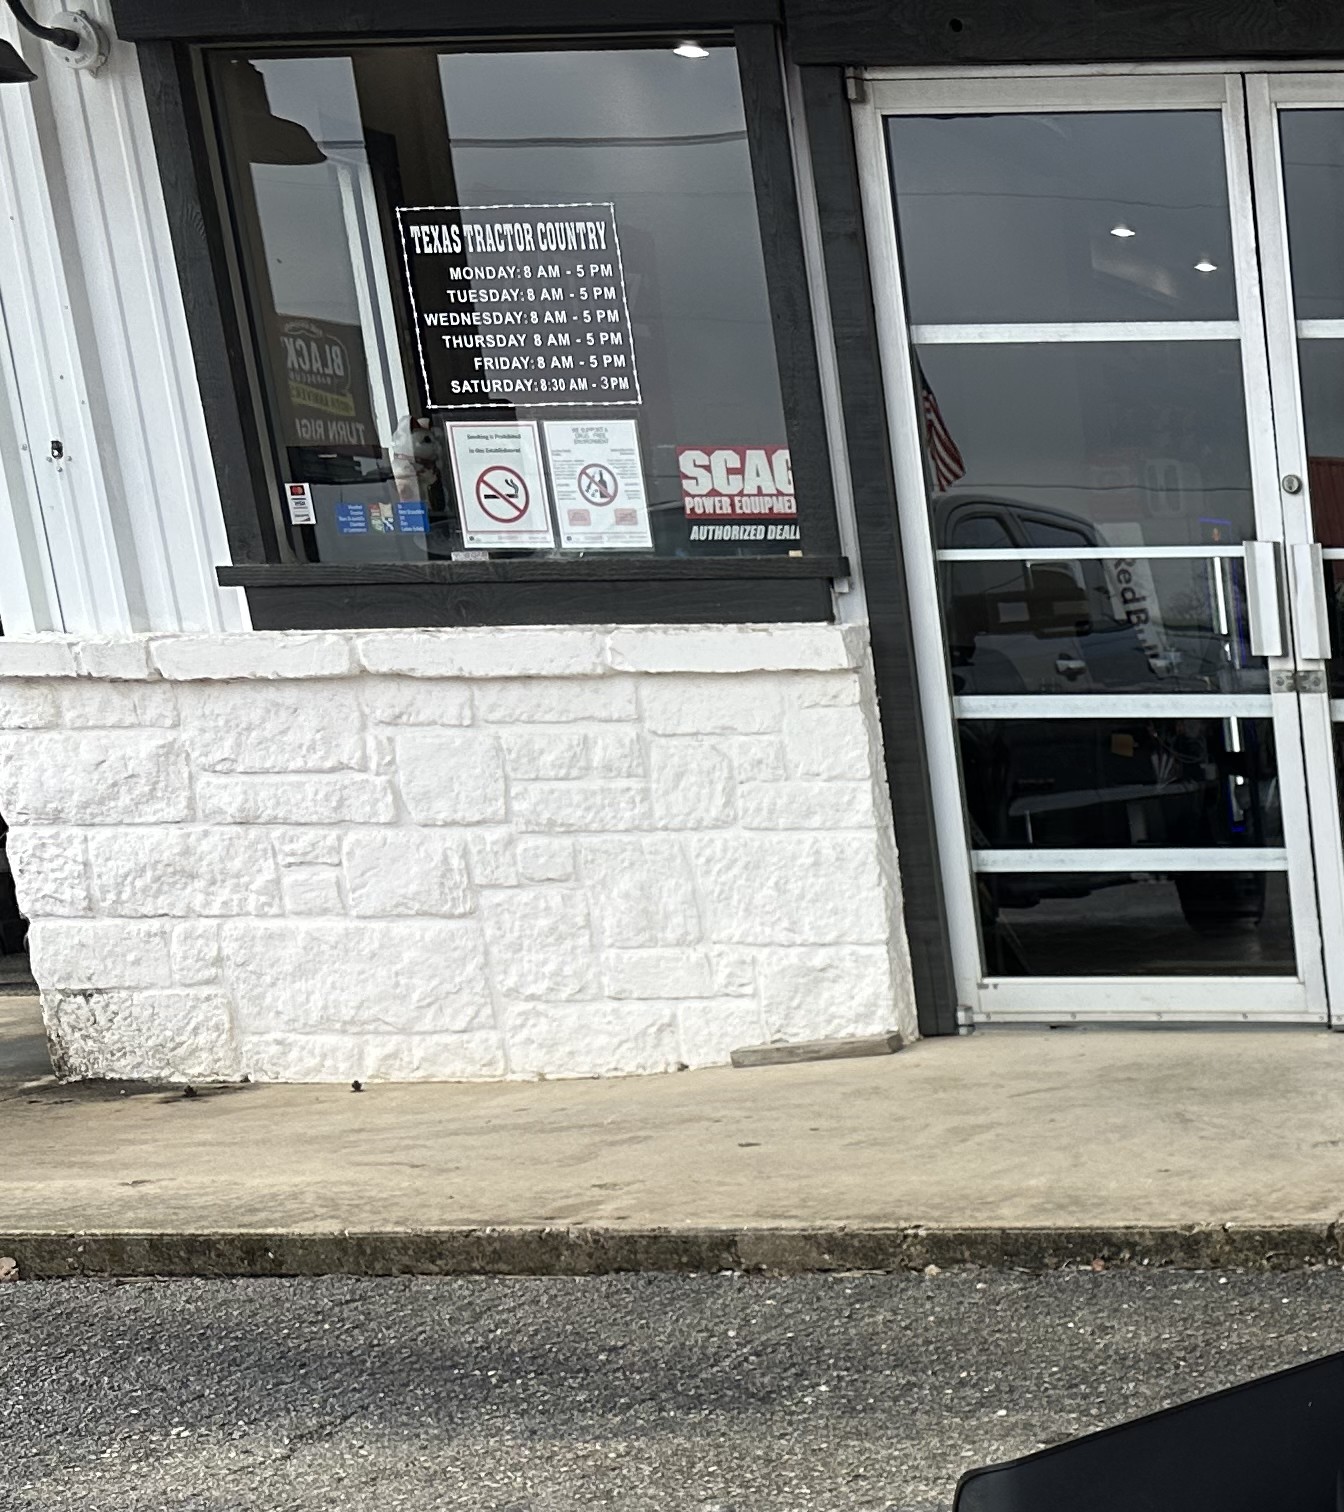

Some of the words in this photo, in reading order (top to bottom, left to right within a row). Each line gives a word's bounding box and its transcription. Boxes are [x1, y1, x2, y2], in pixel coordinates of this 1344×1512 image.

[410, 224, 461, 254] TEXAS
[463, 223, 535, 252] TRACTOR
[537, 221, 607, 250] COUNTRY
[449, 266, 521, 280] MONDAY:
[523, 265, 532, 278] 8
[537, 265, 560, 278] AM
[576, 264, 585, 277] 5
[590, 263, 613, 277] PM
[447, 289, 524, 303] TUESDAY:
[527, 288, 536, 301] 8
[540, 288, 564, 301] AM
[579, 287, 588, 300] 5
[593, 286, 616, 300] PM
[424, 311, 528, 326] WEDNESDAY:
[530, 311, 539, 324] 8
[543, 310, 567, 323] AM
[583, 310, 592, 322] 5
[596, 309, 620, 323] PM
[442, 334, 527, 349] THURSDAY
[533, 334, 542, 346] 8
[547, 333, 570, 346] AM
[586, 333, 595, 345] 5
[599, 332, 623, 345] PM
[474, 357, 535, 370] FRIDAY:
[537, 356, 545, 369] 8
[551, 356, 574, 368] AM
[589, 355, 598, 368] 5
[603, 354, 626, 368] PM
[451, 379, 539, 393] SATURDAY:
[540, 378, 566, 391] 8:30
[569, 378, 588, 391] AM
[600, 376, 609, 389] 3
[610, 377, 629, 390] PM
[685, 496, 732, 515] POWER
[690, 525, 766, 541] AUTHORIZED
